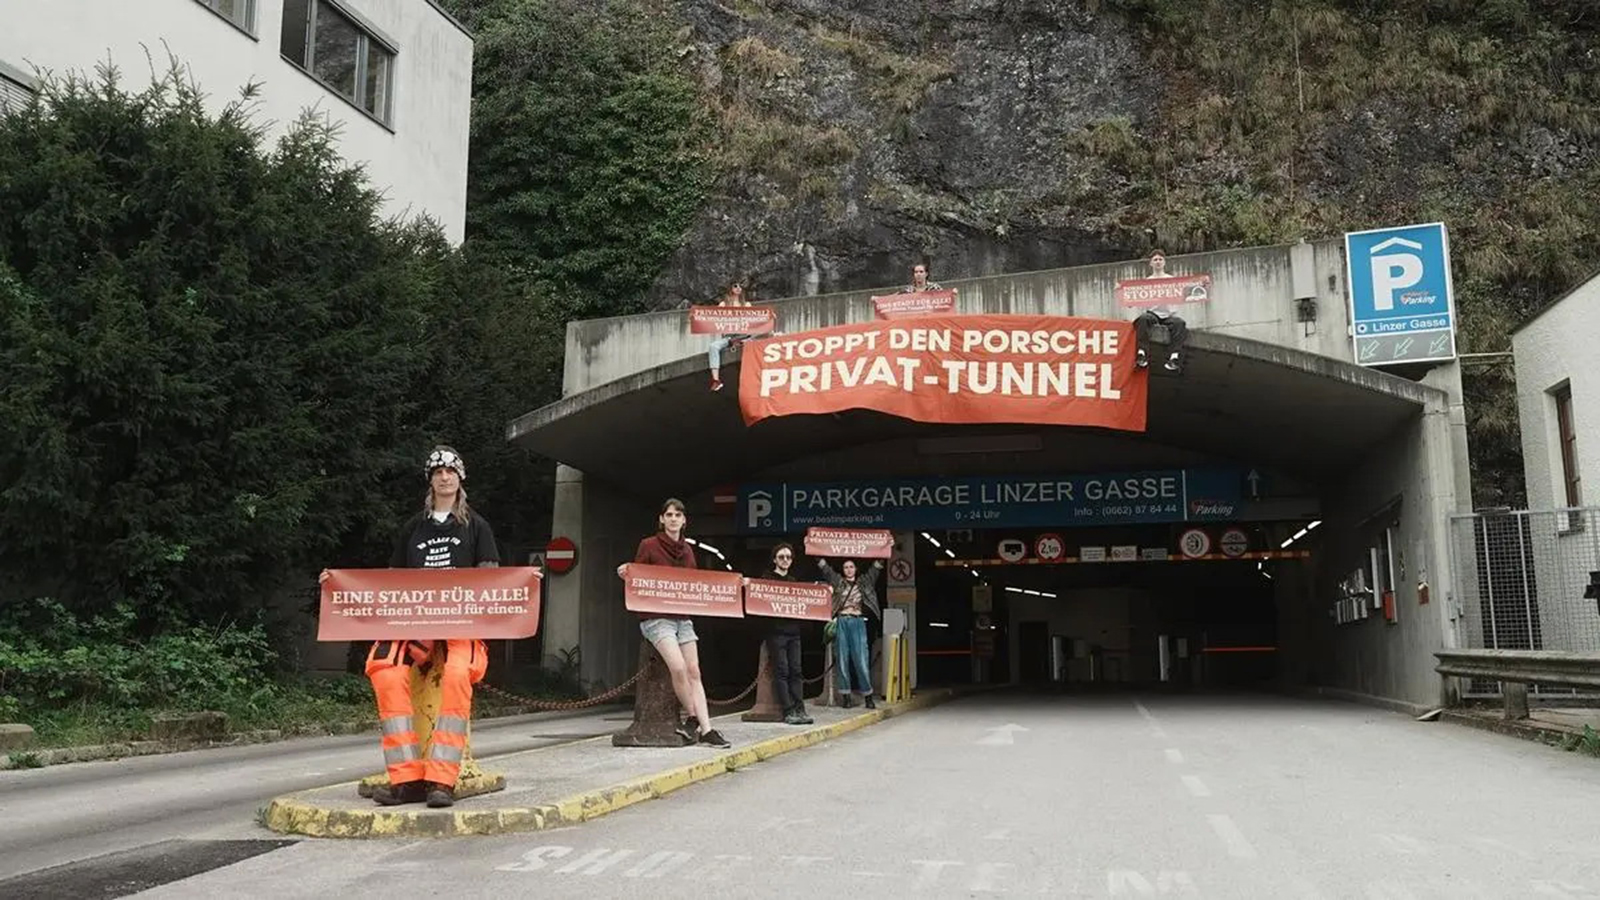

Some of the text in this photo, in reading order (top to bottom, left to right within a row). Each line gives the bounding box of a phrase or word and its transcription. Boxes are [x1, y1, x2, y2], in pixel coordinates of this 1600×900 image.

[1371, 253, 1424, 311] P
[1123, 288, 1183, 300] STOPPEN
[694, 309, 733, 317] PRIVATER
[1372, 318, 1446, 332] Linzer Gasse
[763, 328, 1119, 363] STOPPT DEN PORSCHE
[760, 355, 1121, 400] PRIVAT-TUNNEL
[793, 477, 1177, 509] PARKGARAGE LINZER GASSE
[970, 511, 981, 520] 24
[983, 510, 1001, 520] Uhr
[1074, 506, 1093, 516] Info
[1102, 505, 1133, 517] (0662)
[1164, 504, 1177, 513] 44
[1195, 503, 1233, 517] Parking
[850, 532, 887, 540] TUNNEL?
[831, 544, 867, 554] WTF!?
[632, 578, 737, 595] EINE STADT FÜR ALLE!
[750, 583, 828, 598] PRIVATER TUNNEL?
[332, 586, 529, 604] EINE STADT FÜR ALLE!
[638, 589, 655, 597] statt
[677, 592, 702, 600] Tunnel
[703, 593, 714, 601] für
[714, 595, 737, 603] einen.
[343, 605, 373, 617] statt
[376, 604, 412, 616] einen
[415, 603, 462, 616] Tunnel
[464, 604, 485, 615] für
[486, 602, 528, 614] einen.
[771, 602, 807, 615] WTF!?
